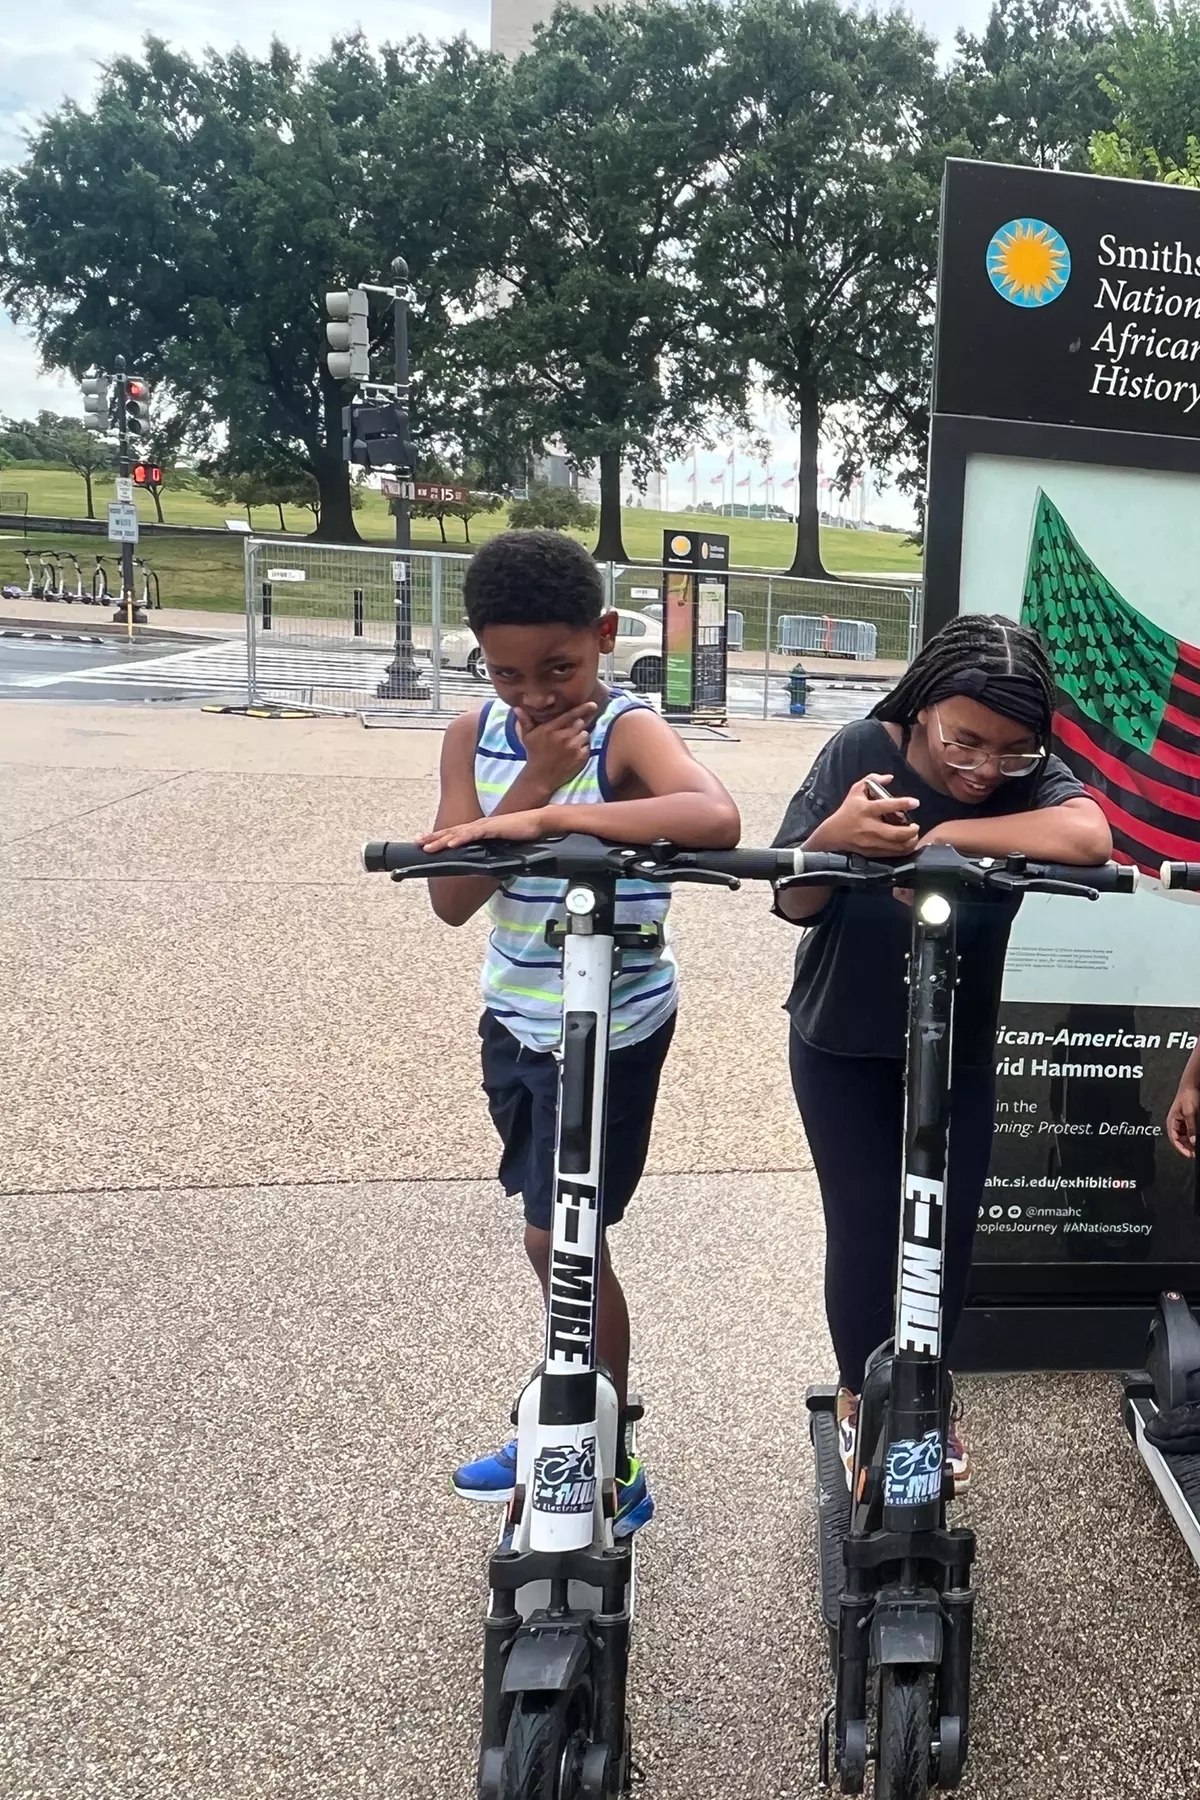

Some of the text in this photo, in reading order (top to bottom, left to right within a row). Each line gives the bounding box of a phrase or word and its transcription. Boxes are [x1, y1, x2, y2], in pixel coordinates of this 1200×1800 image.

[996, 1026, 1199, 1050] ican-American Fla
[996, 1057, 1144, 1078] vid Hammons
[996, 1099, 1038, 1113] in the
[993, 1120, 1163, 1138] oning: Protest. Defiance.
[984, 1175, 1137, 1191] ahc.si.edu/exhibitions
[1025, 1205, 1082, 1219] @nmaahc
[976, 1221, 1153, 1236] eoplesJourney #ANationsStory
[548, 1178, 599, 1366] E-MILE
[899, 1173, 945, 1357] E-MILE
